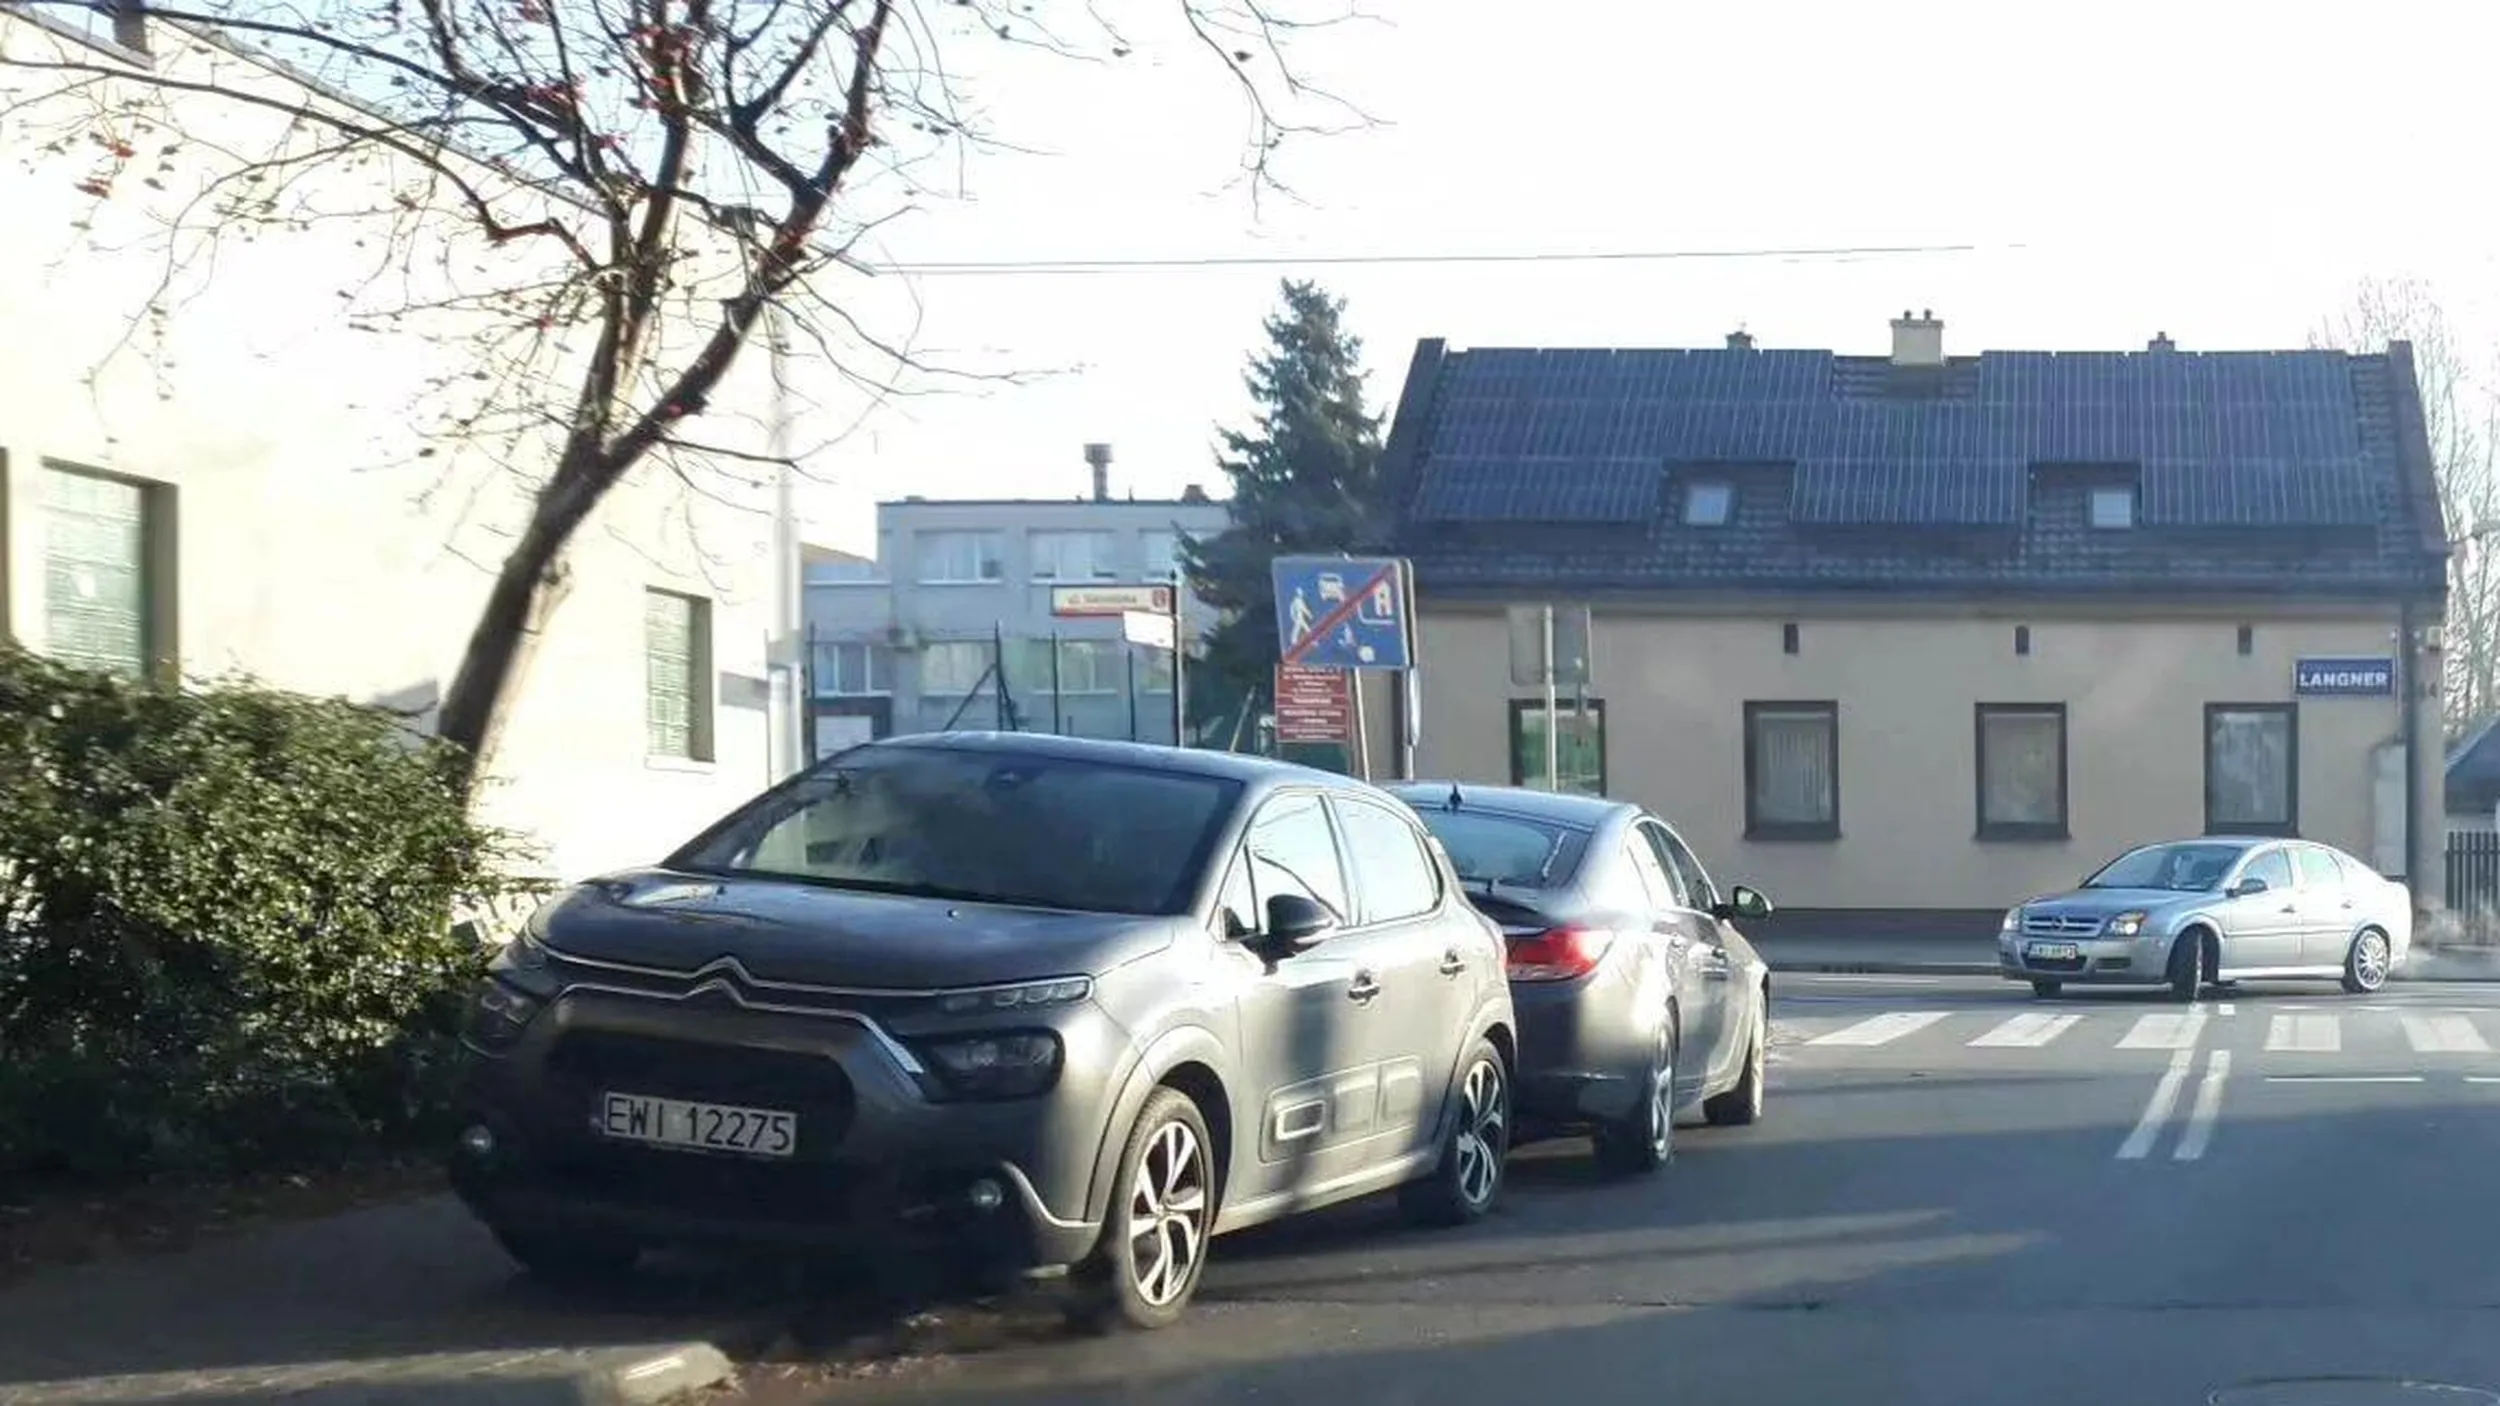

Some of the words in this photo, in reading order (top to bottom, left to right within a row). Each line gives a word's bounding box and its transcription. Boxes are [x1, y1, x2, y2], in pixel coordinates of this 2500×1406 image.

[2299, 671, 2389, 687] LANGNER
[606, 1096, 664, 1138] EWI
[685, 1106, 791, 1152] 12275
